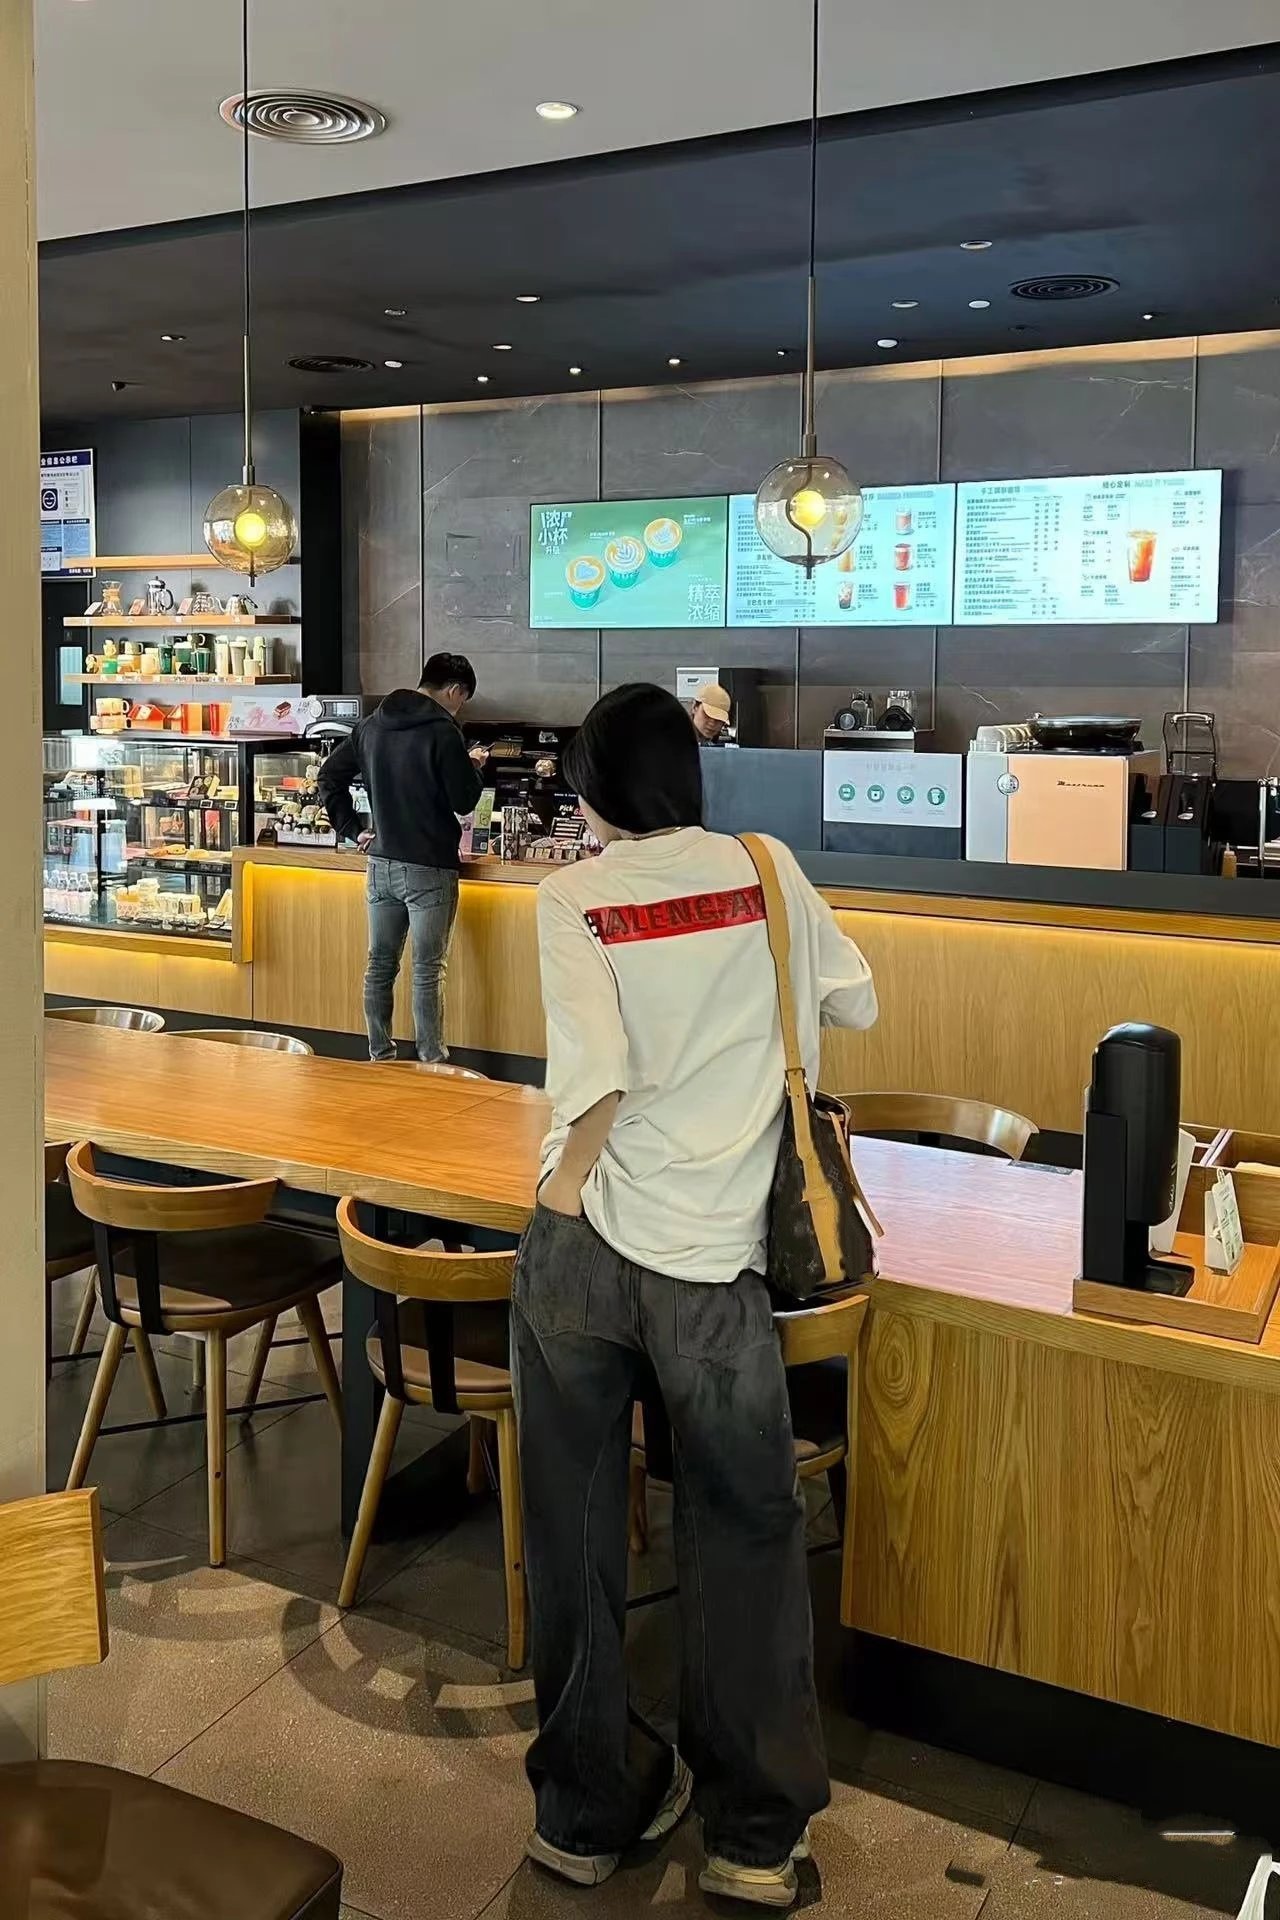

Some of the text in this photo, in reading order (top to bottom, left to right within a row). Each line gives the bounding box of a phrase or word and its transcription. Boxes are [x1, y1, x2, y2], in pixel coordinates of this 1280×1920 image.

[538, 527, 568, 546] 小杯
[688, 583, 721, 602] 精萃
[688, 603, 721, 622] 浓缩
